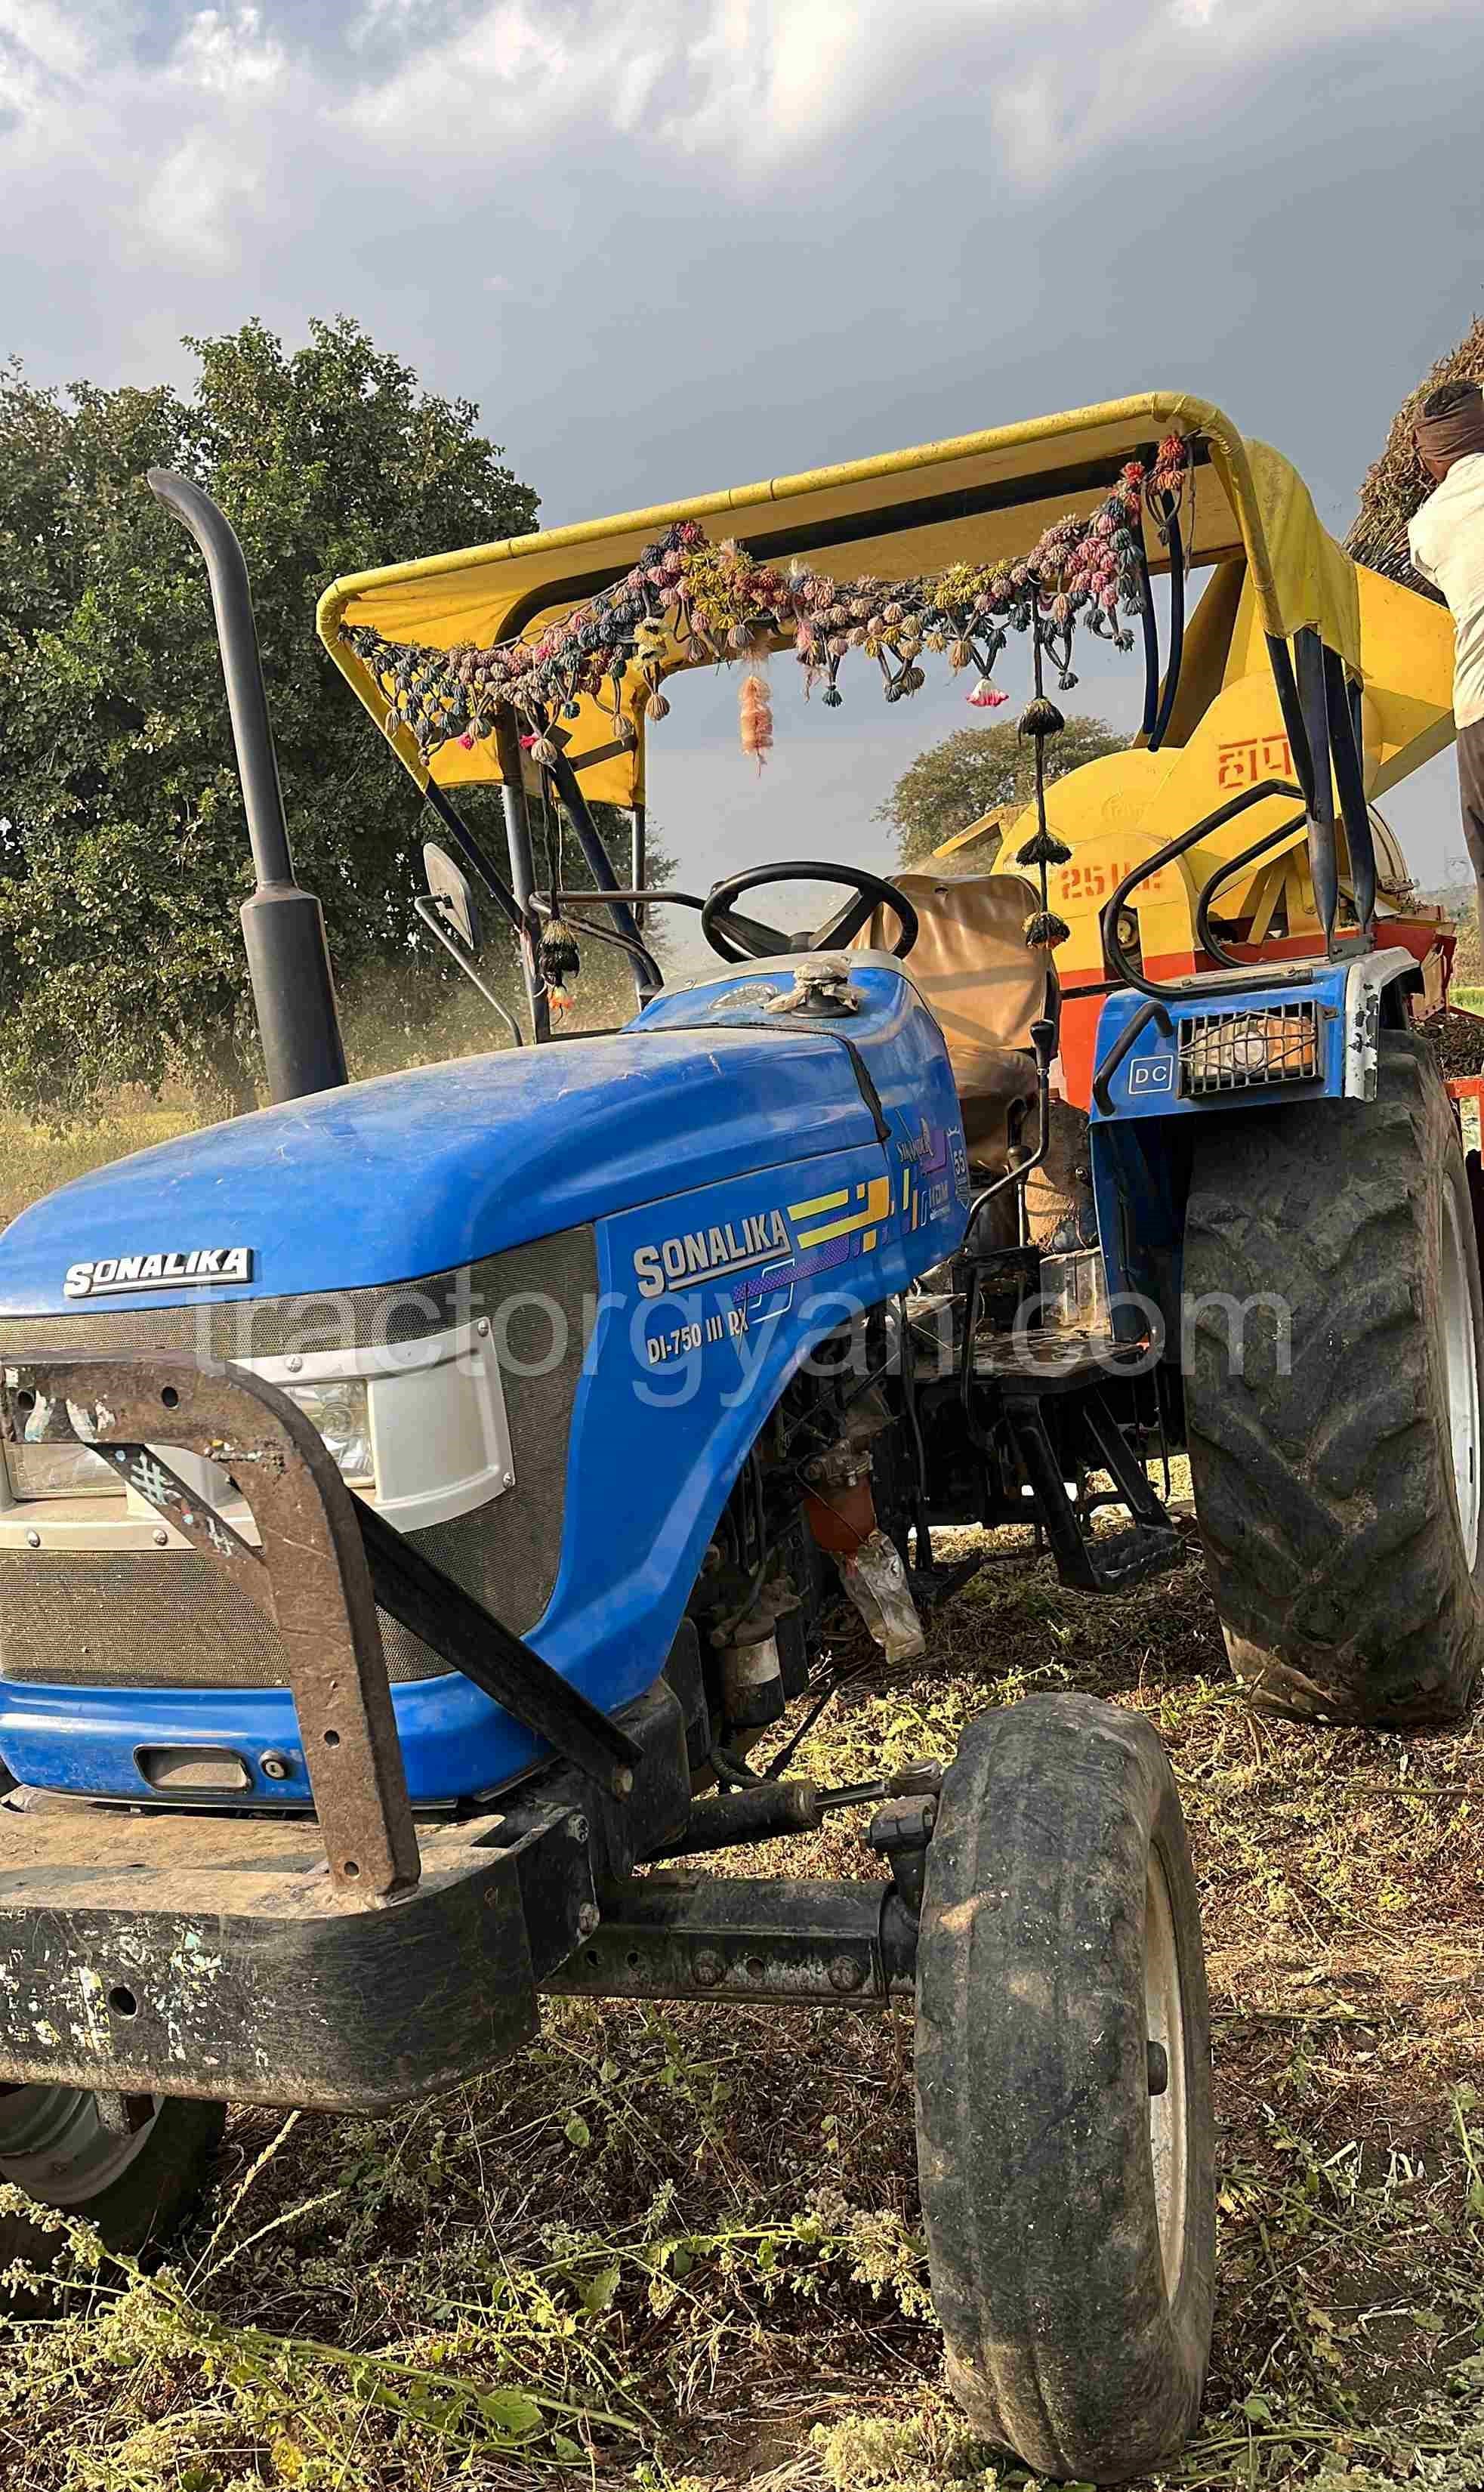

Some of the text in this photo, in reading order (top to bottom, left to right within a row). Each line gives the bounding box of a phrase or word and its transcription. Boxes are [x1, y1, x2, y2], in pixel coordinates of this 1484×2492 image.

[1061, 867, 1105, 900] 25
[1135, 1065, 1167, 1084] DC
[953, 1148, 967, 1175] 55
[63, 1246, 254, 1298] SONALIKA
[634, 1209, 792, 1299] SONALIKA
[646, 1322, 702, 1365] DI-750
